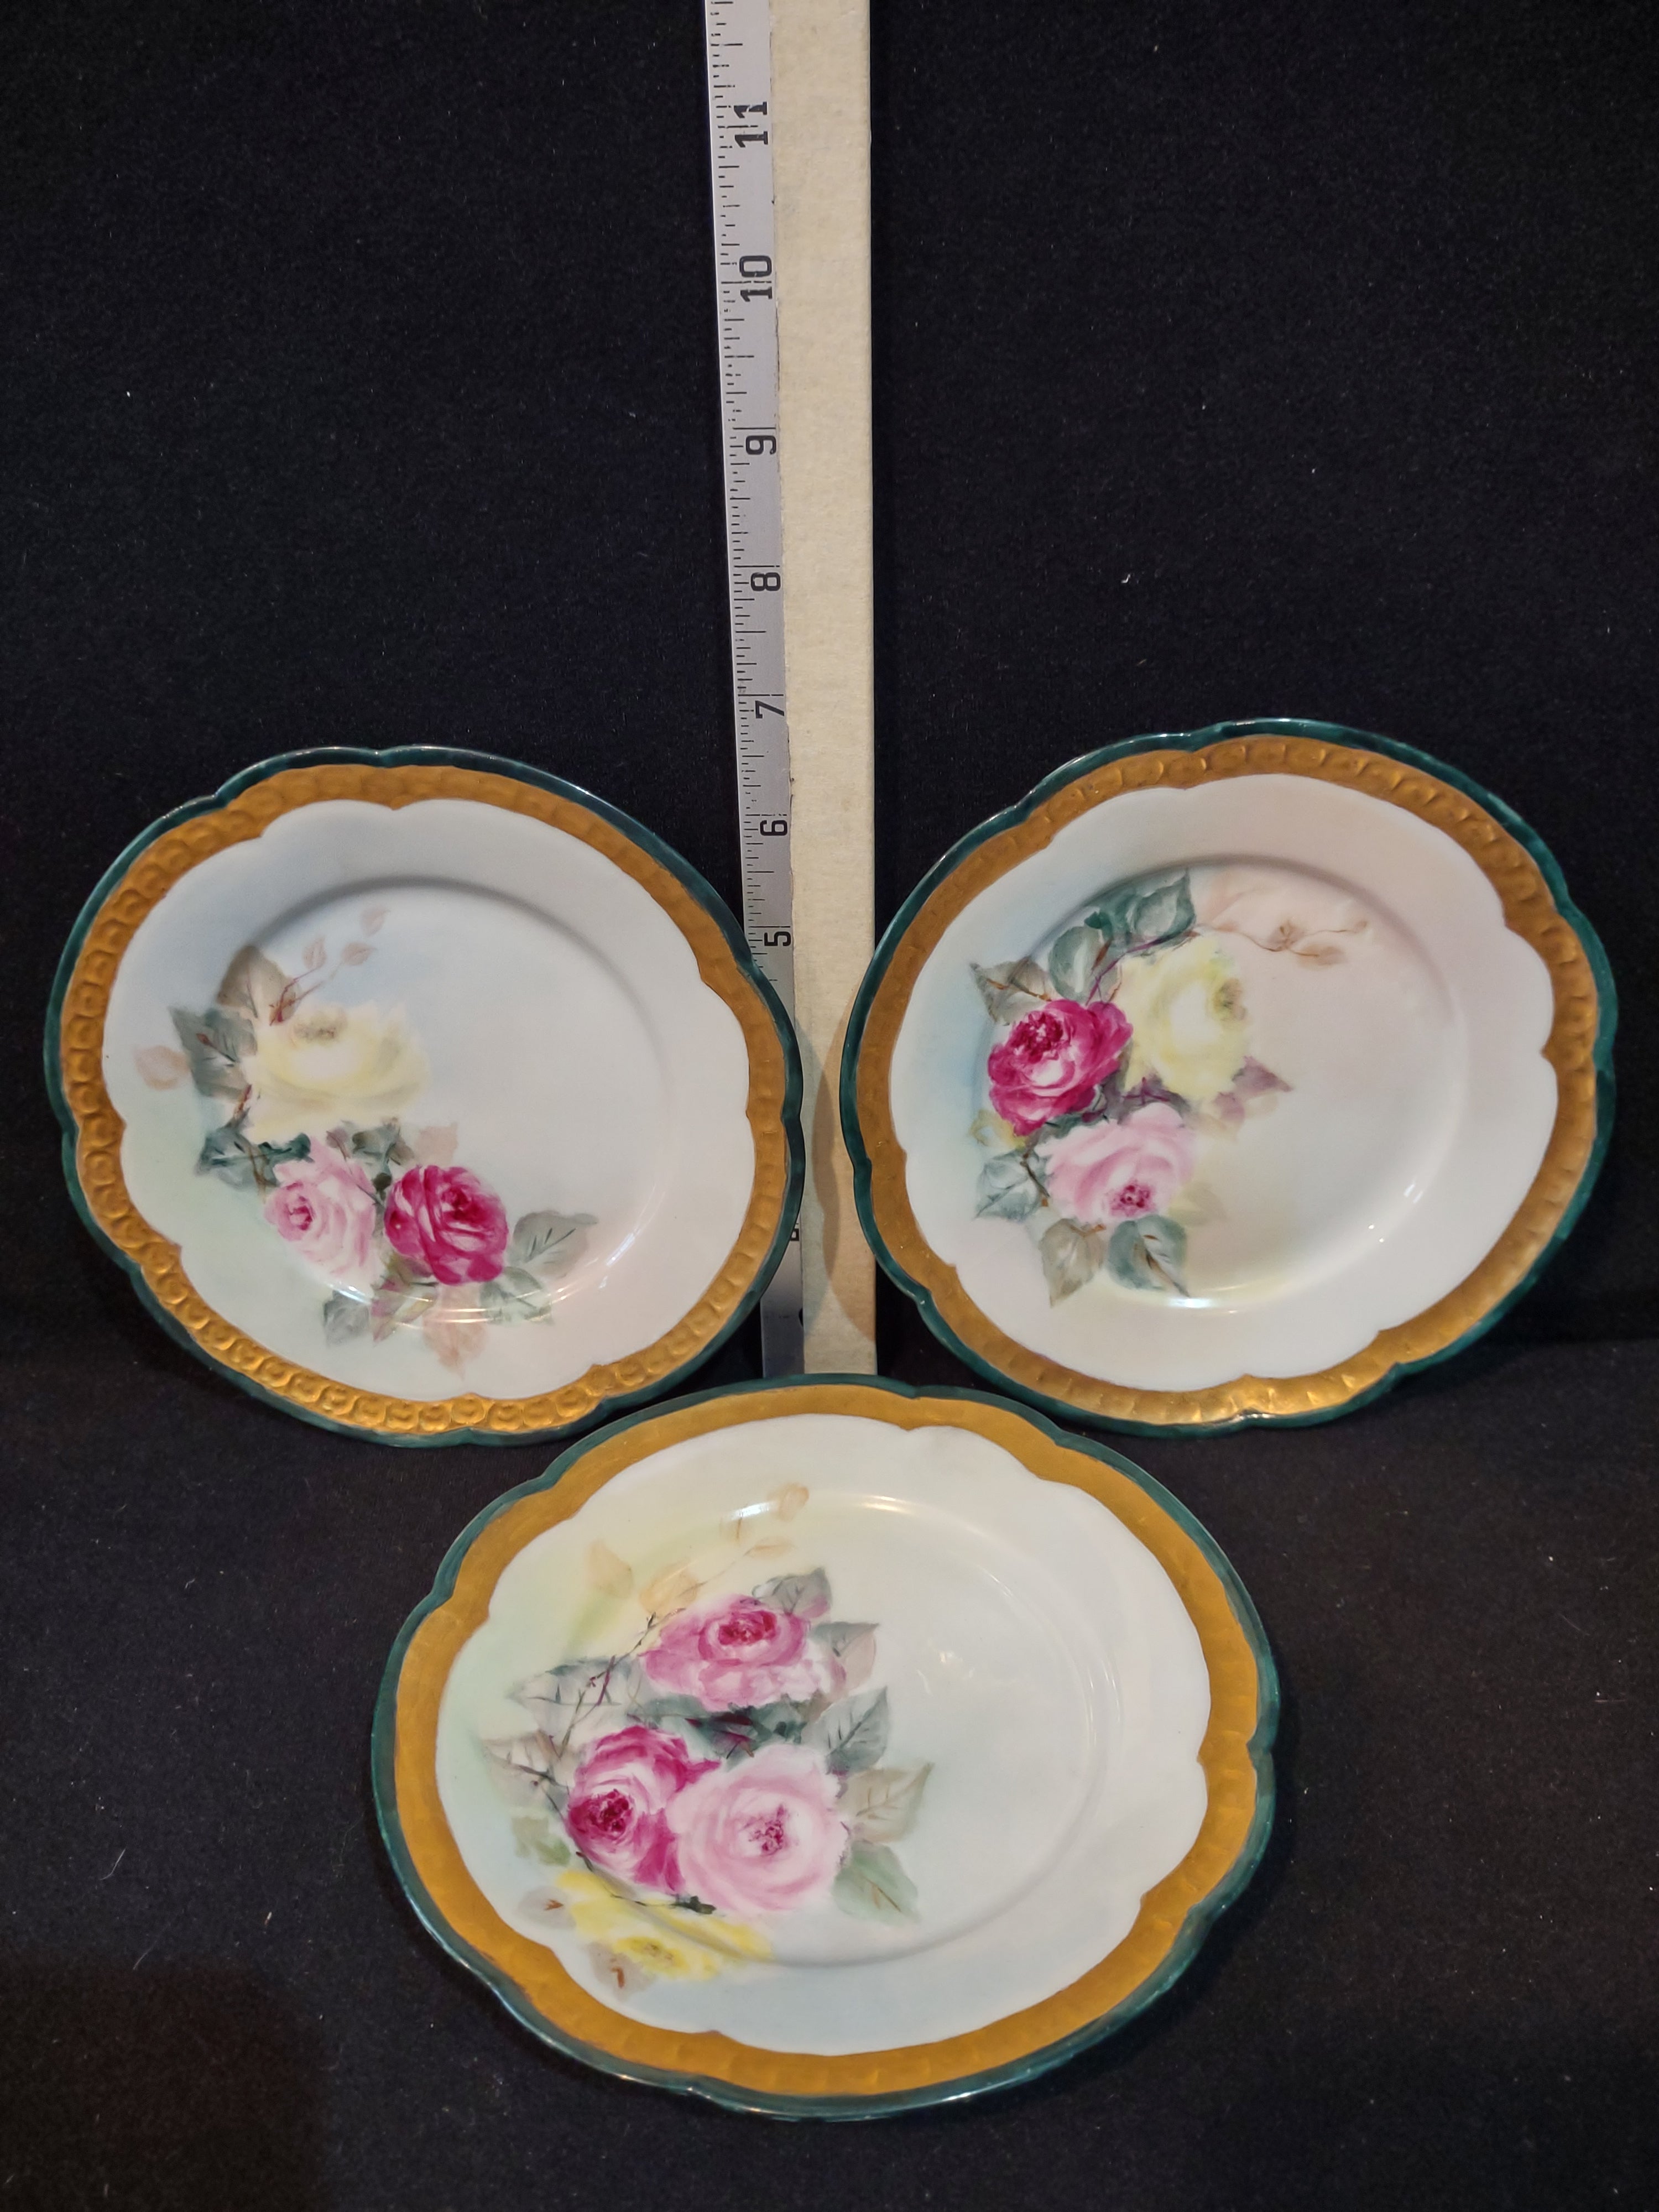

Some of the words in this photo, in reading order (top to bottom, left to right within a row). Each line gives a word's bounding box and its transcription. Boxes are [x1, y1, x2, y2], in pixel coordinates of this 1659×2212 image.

[734, 102, 768, 148] 11
[739, 255, 773, 302] 10
[745, 435, 777, 455] 9
[750, 572, 781, 591] 8
[755, 700, 785, 719] 7
[760, 820, 787, 836] 6
[764, 931, 791, 947] 5
